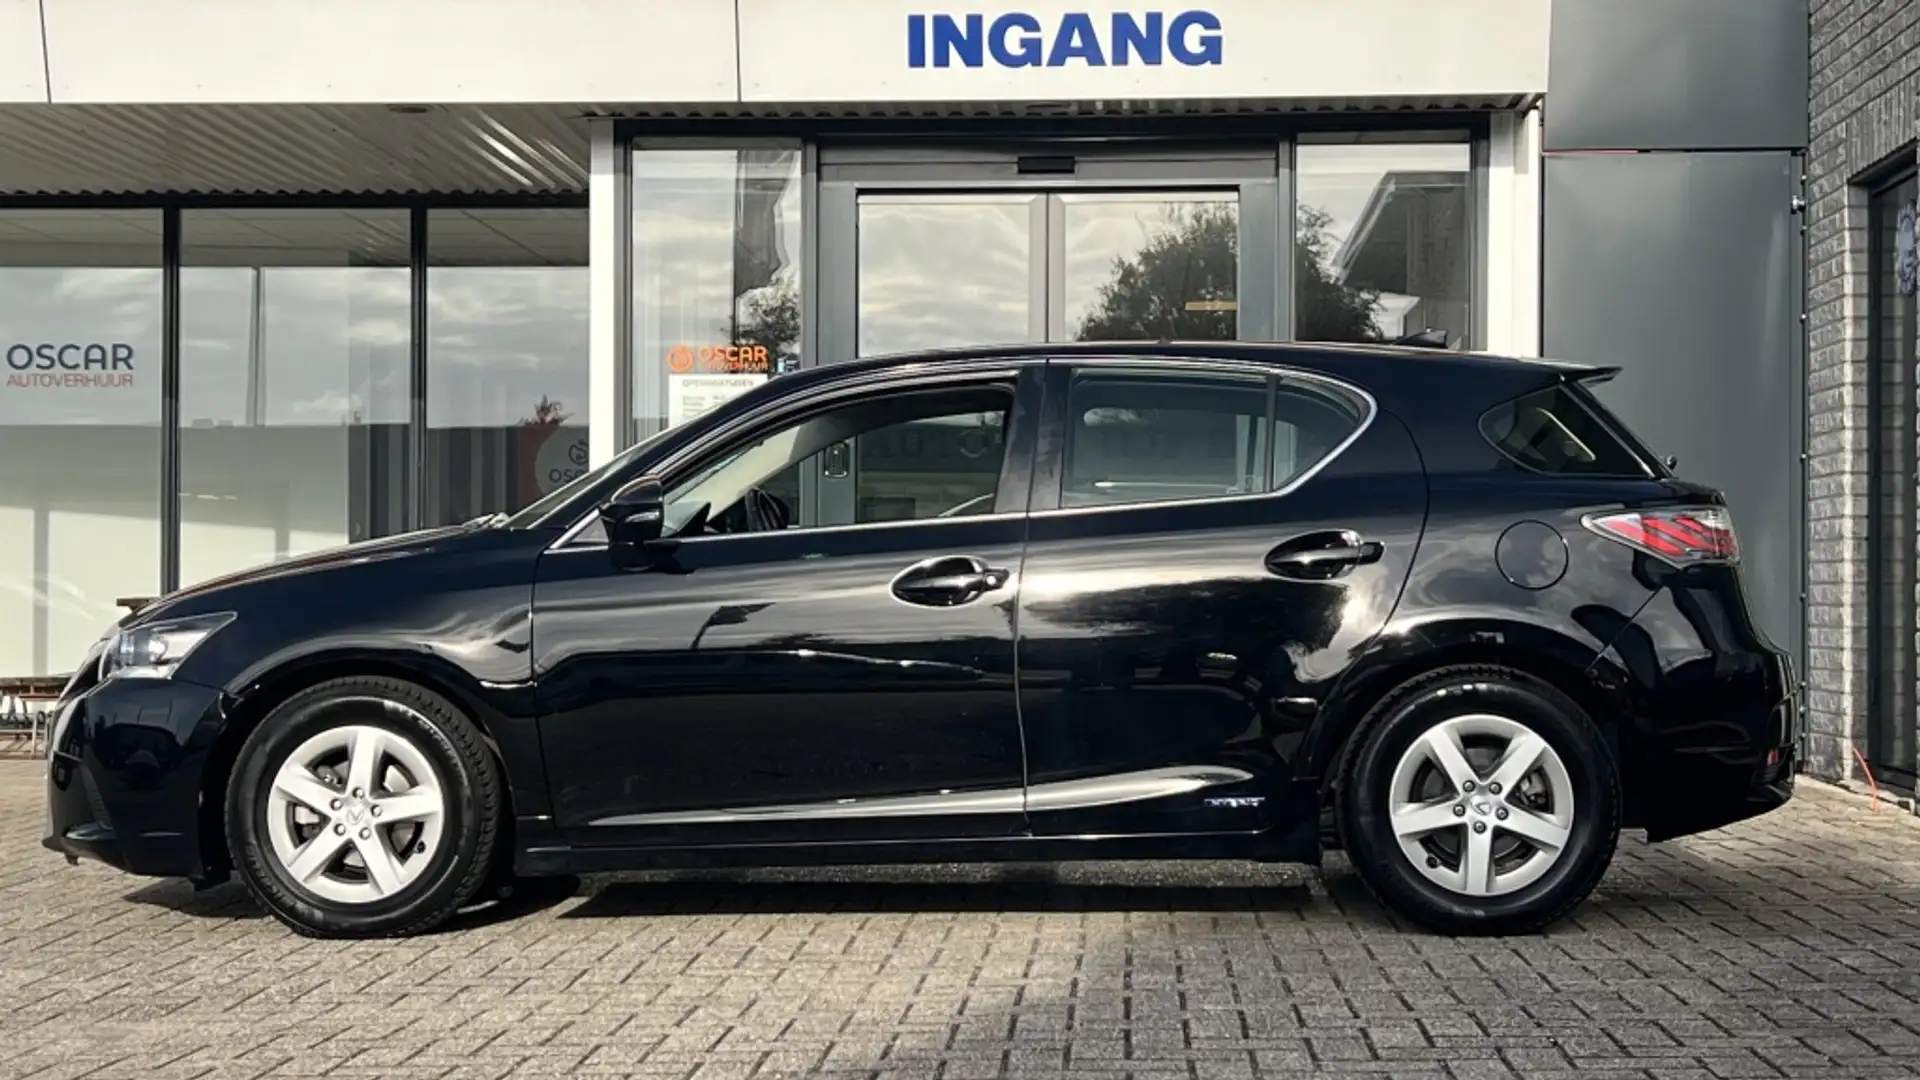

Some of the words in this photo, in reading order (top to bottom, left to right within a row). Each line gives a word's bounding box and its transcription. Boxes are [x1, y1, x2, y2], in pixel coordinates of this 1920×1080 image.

[907, 10, 1223, 68] INGANG
[6, 343, 134, 370] OSCAR
[698, 345, 768, 361] OSCAR
[6, 373, 134, 388] AUTOVERHUUR
